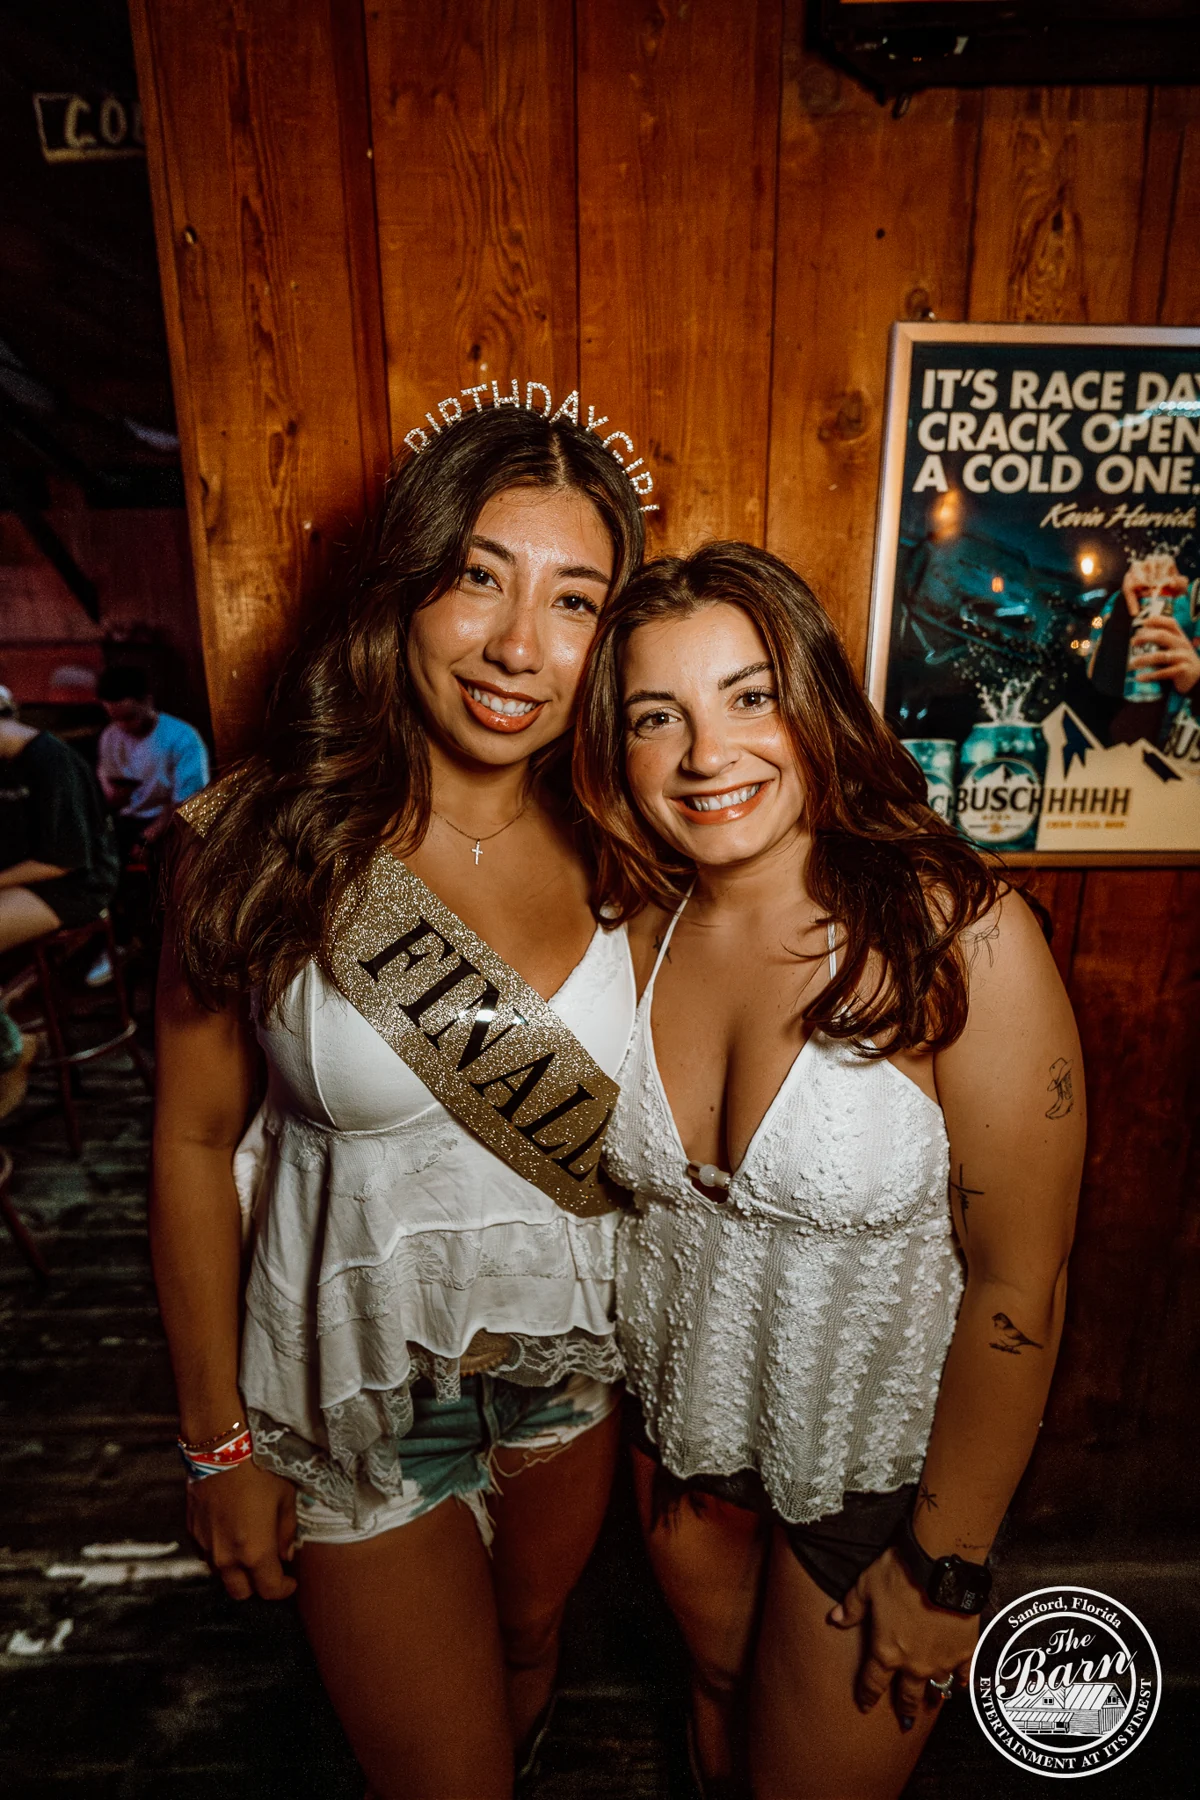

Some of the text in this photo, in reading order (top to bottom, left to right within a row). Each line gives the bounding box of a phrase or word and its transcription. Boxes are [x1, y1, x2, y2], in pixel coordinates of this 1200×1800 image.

[921, 368, 1200, 412] IT'S RACE DA
[917, 411, 1200, 454] CRACK OPEN
[911, 454, 949, 493] A
[962, 453, 1083, 494] COLD
[357, 915, 613, 1184] FINALL
